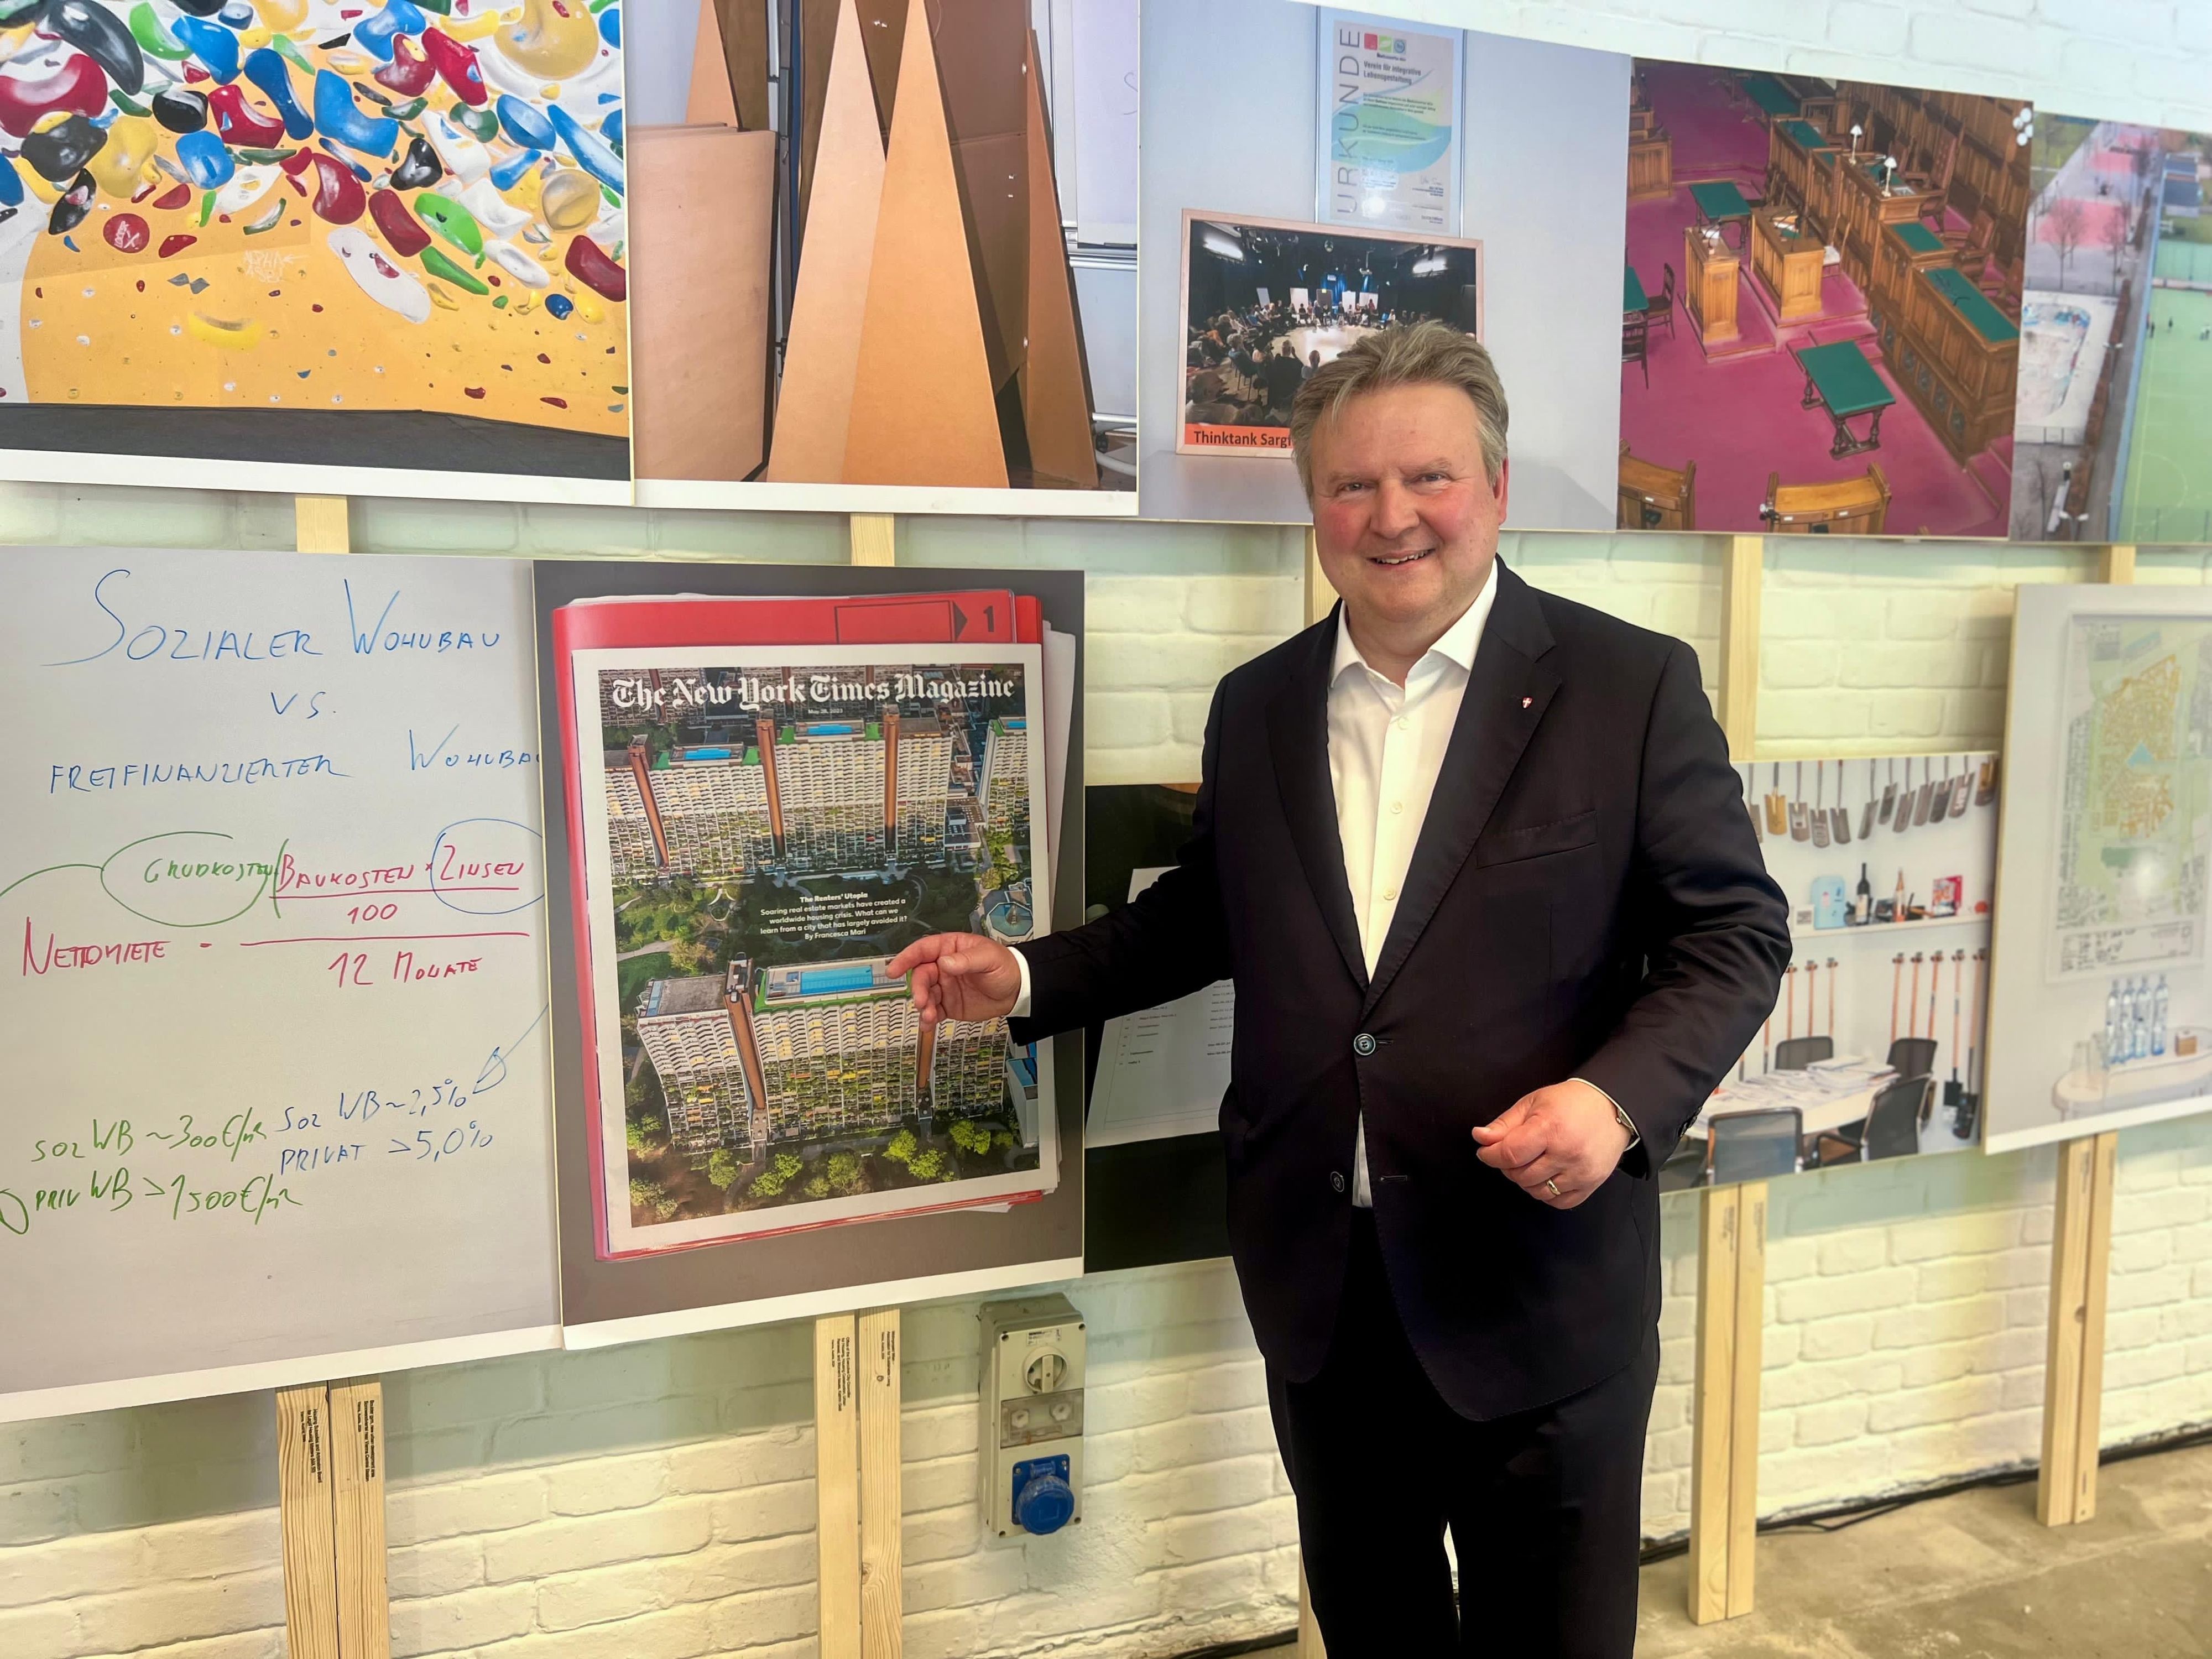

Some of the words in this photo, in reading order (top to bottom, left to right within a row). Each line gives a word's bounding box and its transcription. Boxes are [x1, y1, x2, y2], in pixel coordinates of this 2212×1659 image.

[1363, 61, 1381, 70] Verein
[1383, 62, 1391, 71] für
[1337, 29, 1360, 214] URKUNDE
[1193, 430, 1258, 445] Thinktank
[40, 569, 324, 666] SOZIALER
[982, 605, 995, 633] 1
[612, 677, 667, 712] The
[672, 677, 733, 708] New
[737, 676, 806, 712] York
[810, 674, 890, 703] Times
[894, 673, 1015, 705] Magazine
[844, 891, 868, 900] Utopia
[874, 898, 900, 906] created
[347, 903, 398, 925] 100
[769, 916, 806, 924] worldwide
[815, 930, 849, 938] Francesca
[328, 952, 374, 988] 12
[339, 1090, 380, 1123] WB
[92, 1118, 134, 1156] WB
[280, 1144, 367, 1176] PRIVAT
[90, 1166, 133, 1212] WB
